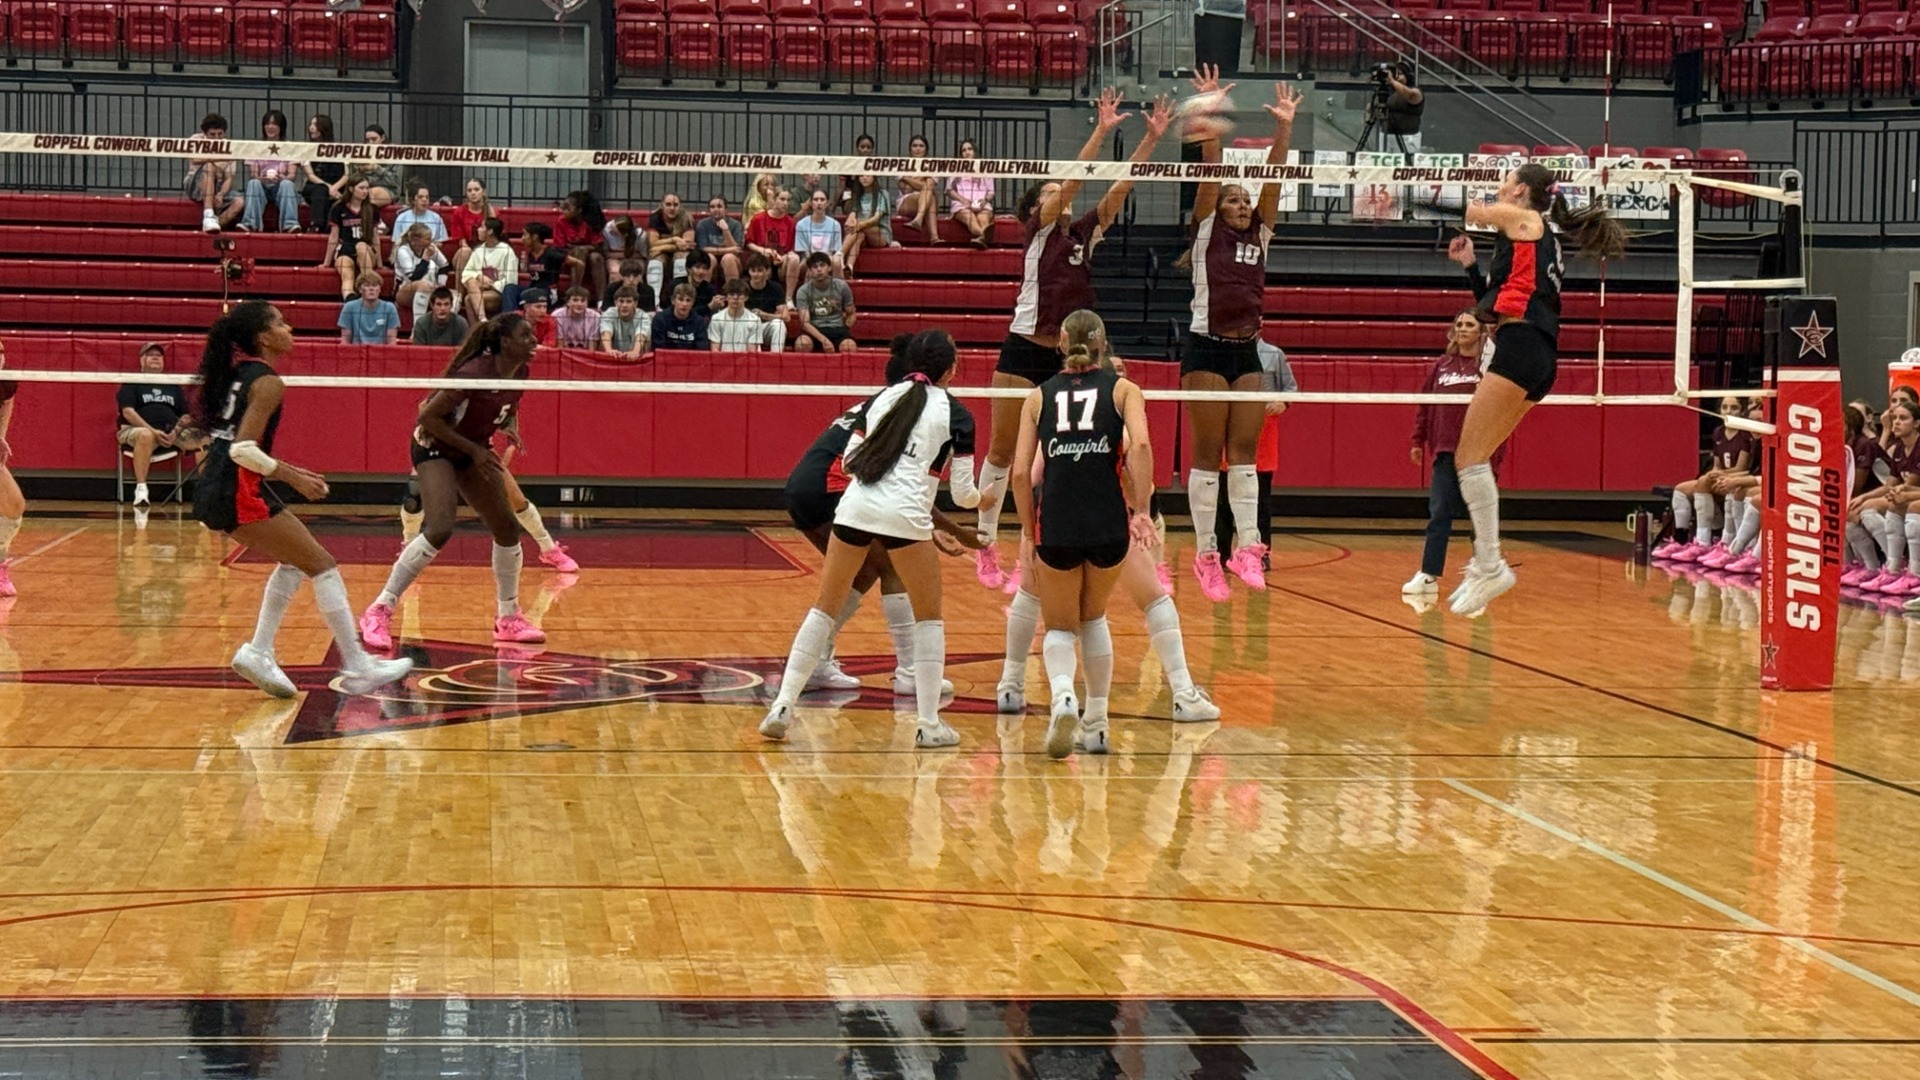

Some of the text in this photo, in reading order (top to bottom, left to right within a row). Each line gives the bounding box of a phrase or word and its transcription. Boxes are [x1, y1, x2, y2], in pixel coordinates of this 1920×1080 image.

[34, 135, 232, 154] COPPELL COWGIRL VOLLEYBALL
[317, 144, 510, 163] COPPELL COWGIRL VOLLEYBALL
[593, 152, 783, 169] COPPELL COWGIRL VOLLEYBALL
[864, 158, 1050, 175] COPPELL COWGIRL VOLLEYBALL
[1130, 163, 1314, 179] COPPELL COWGIRL VOLLEYBALL
[1392, 168, 1444, 181] COPPELL
[1447, 169, 1500, 182] COWGIRL
[1068, 244, 1084, 266] 3
[1235, 242, 1261, 266] 10
[493, 404, 511, 424] 5
[1054, 388, 1098, 432] 17
[1047, 435, 1112, 462] Cowgirls
[1723, 452, 1731, 468] 6
[1786, 403, 1822, 632] COWGIRLS
[1823, 467, 1841, 567] COPPELL
[1766, 529, 1774, 624] sports imports
